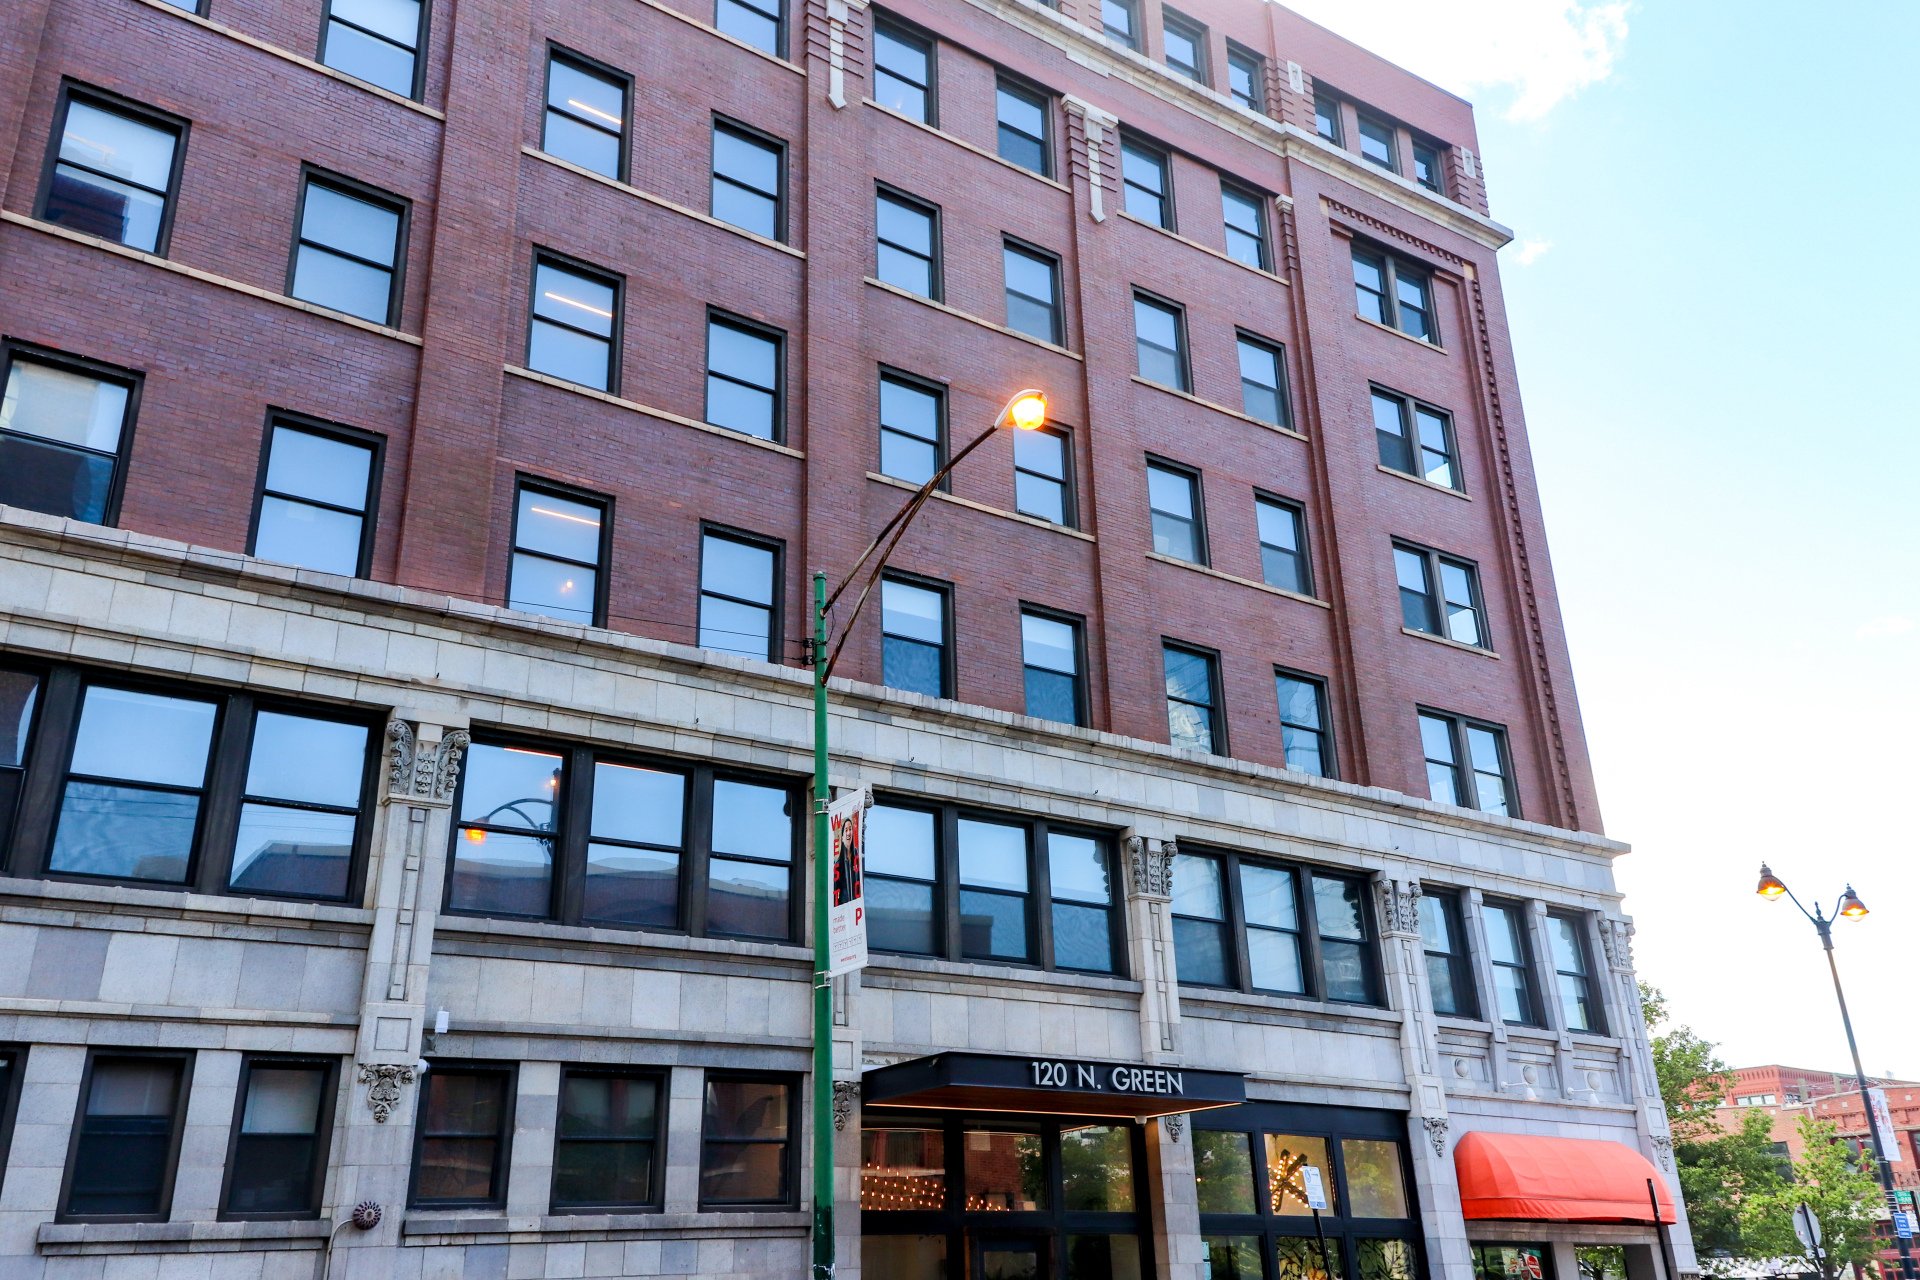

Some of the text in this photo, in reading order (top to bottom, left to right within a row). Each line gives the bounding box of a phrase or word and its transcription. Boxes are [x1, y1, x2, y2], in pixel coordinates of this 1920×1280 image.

[830, 812, 842, 907] WEST
[1032, 1061, 1184, 1095] 120 N. GREEN
